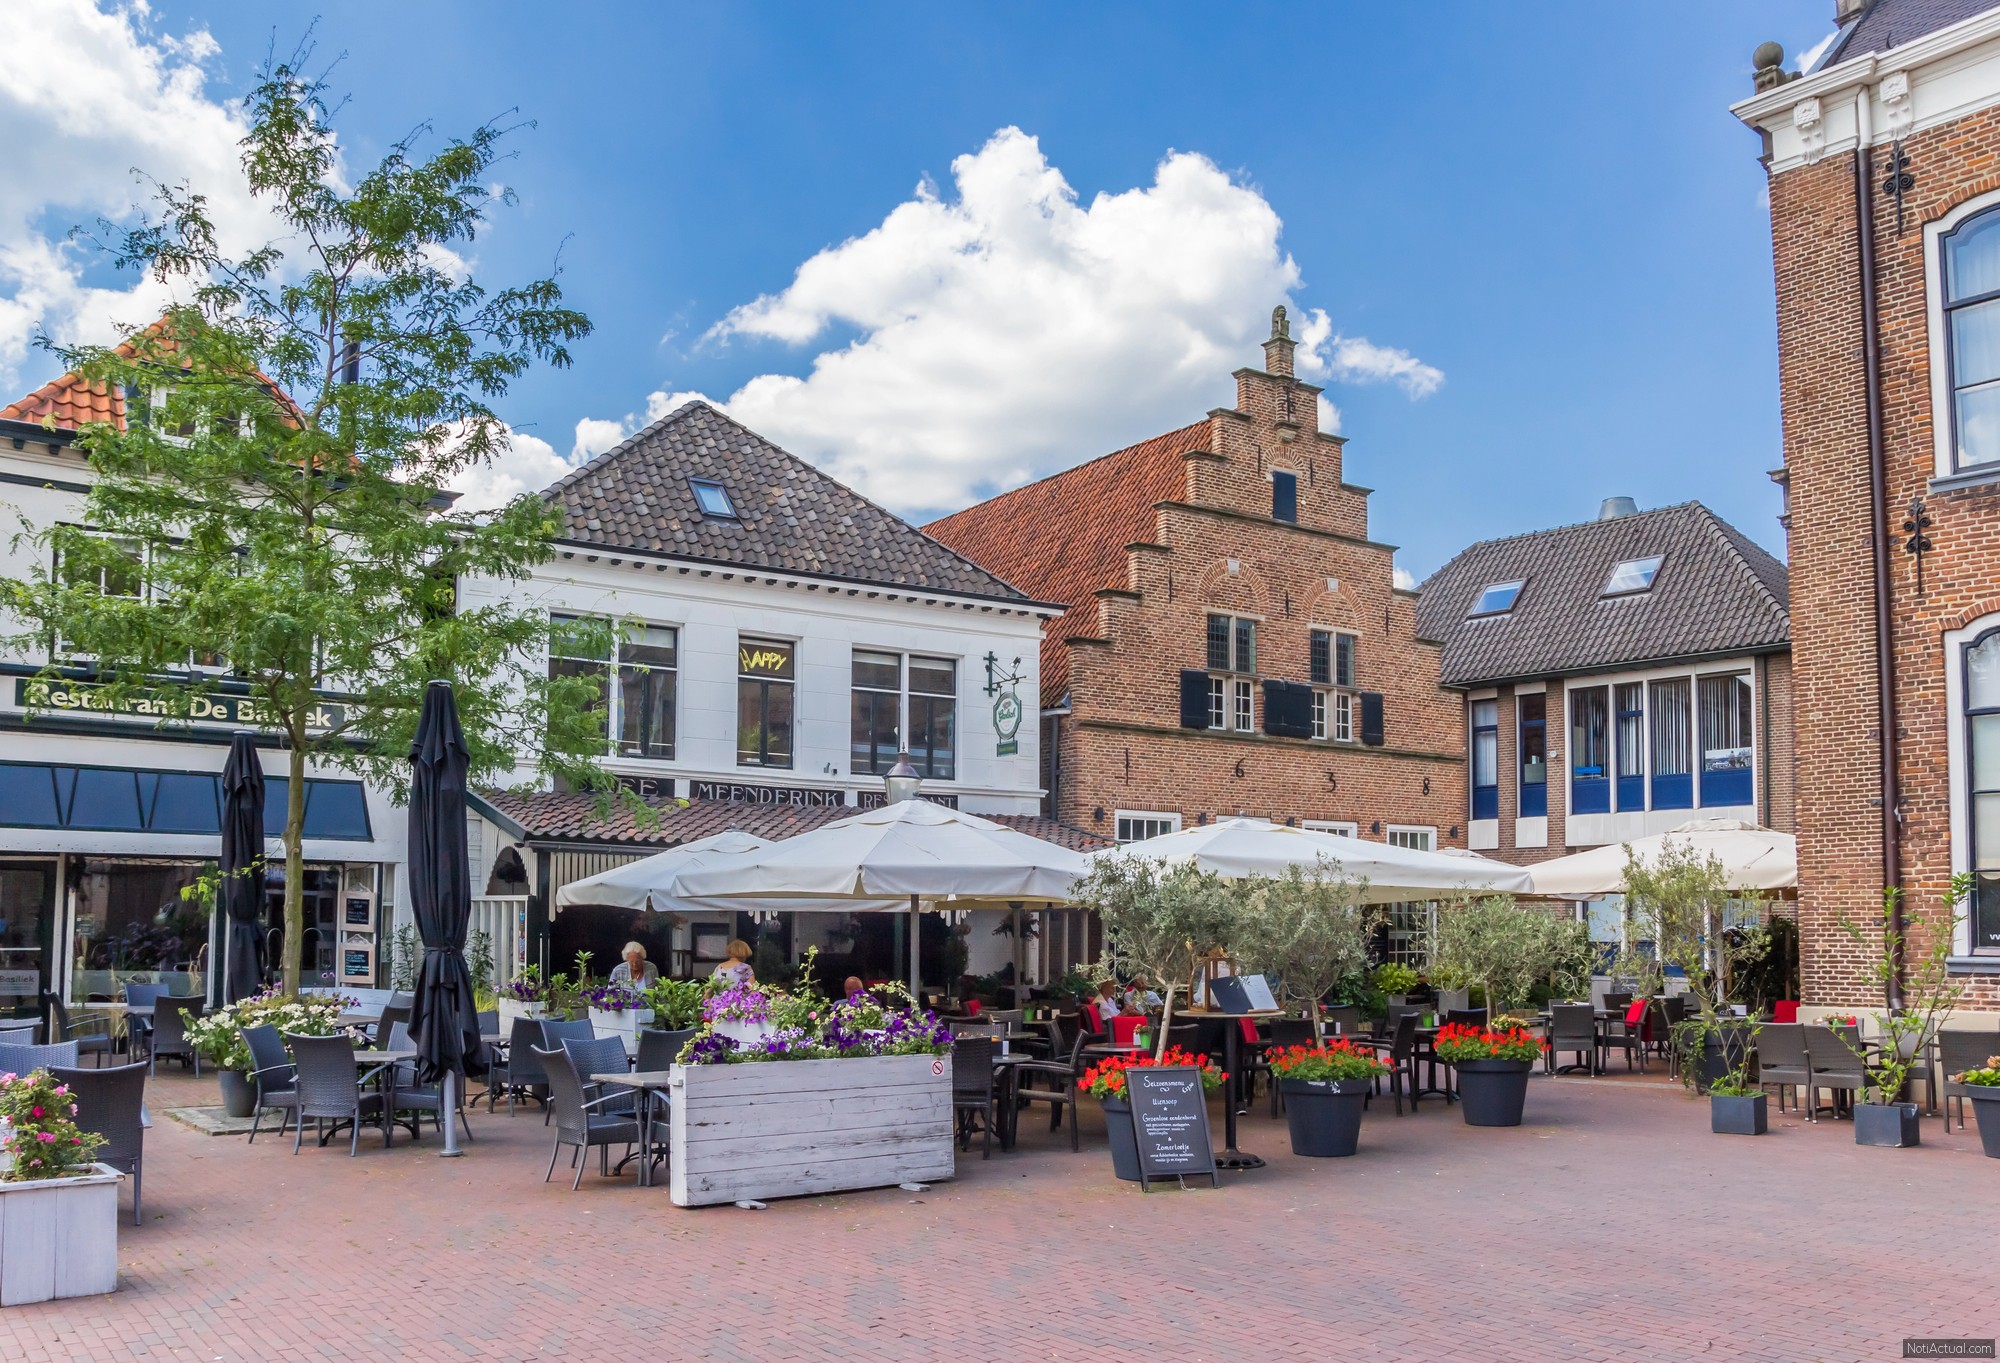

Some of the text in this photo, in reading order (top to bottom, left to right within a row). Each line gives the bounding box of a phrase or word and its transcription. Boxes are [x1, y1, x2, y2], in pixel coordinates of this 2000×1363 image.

[739, 646, 787, 672] HAPPY
[189, 696, 228, 719] De
[695, 783, 839, 807] MEENDERINK
[1143, 1075, 1185, 1088] Seizoensmenu
